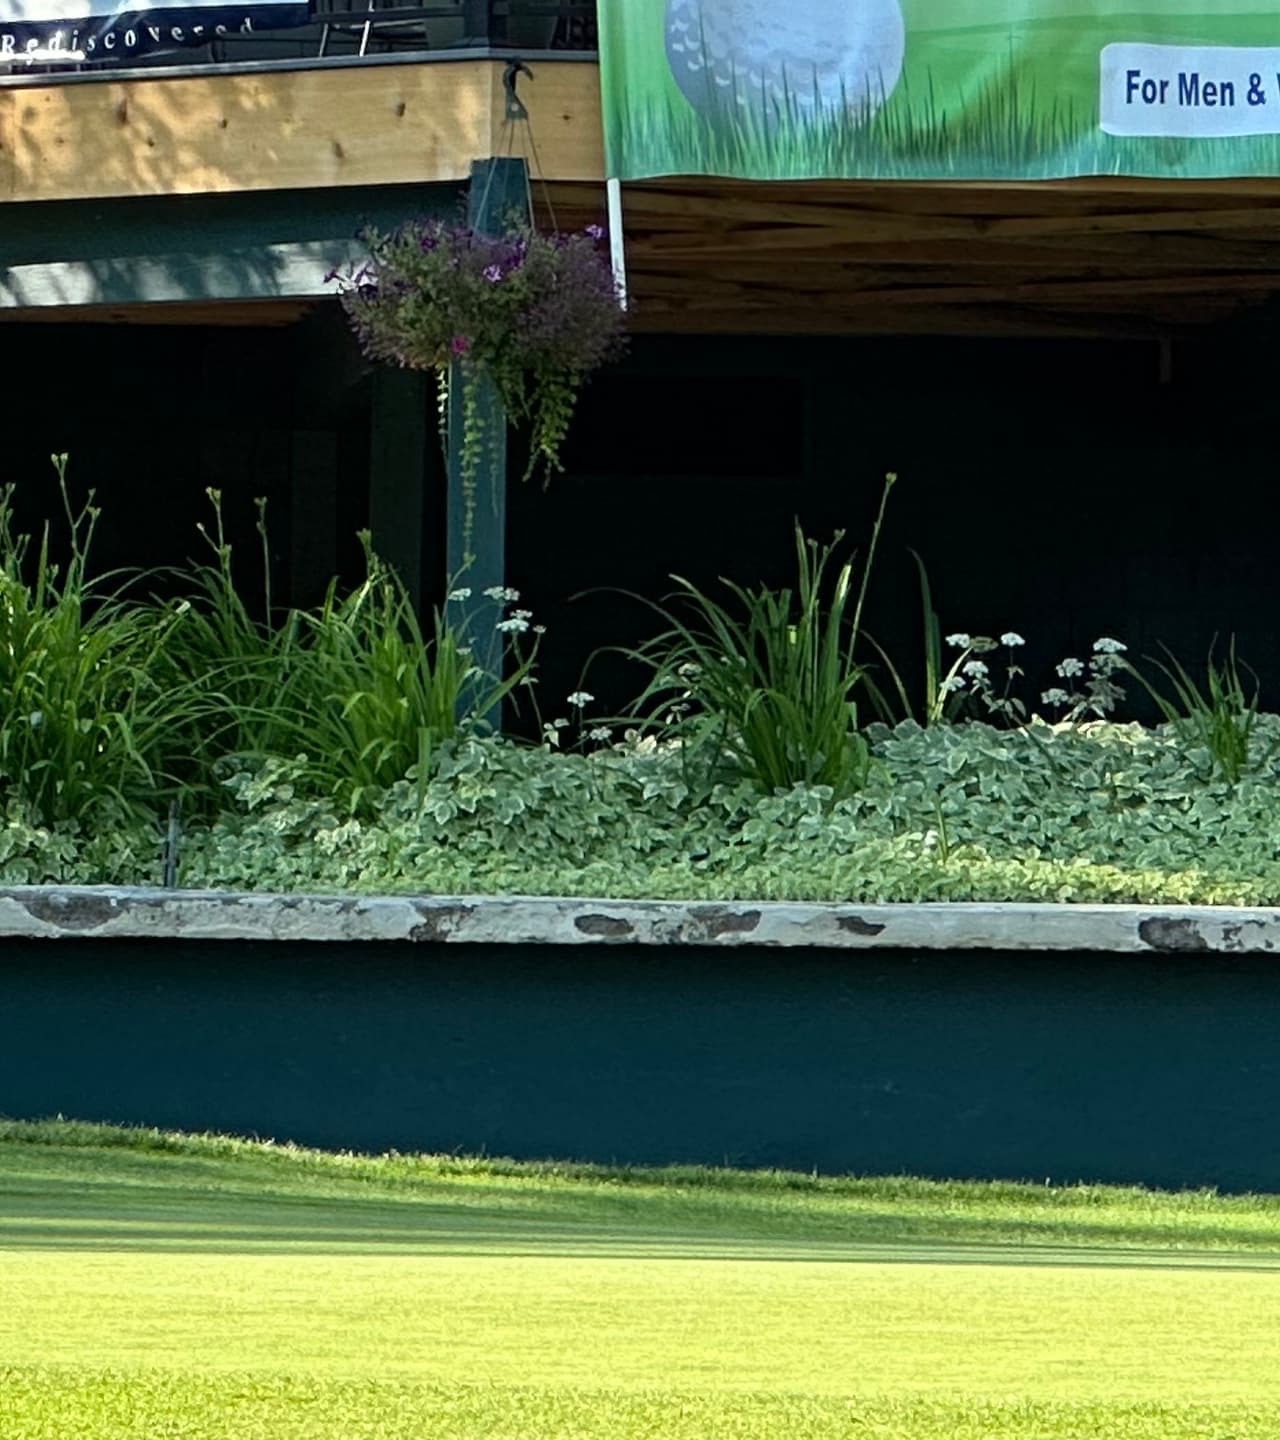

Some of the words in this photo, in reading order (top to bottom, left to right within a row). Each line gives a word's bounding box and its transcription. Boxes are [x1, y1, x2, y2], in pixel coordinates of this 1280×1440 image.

[1125, 69, 1170, 105] For
[1178, 72, 1236, 107] Men
[1246, 72, 1267, 106] &
